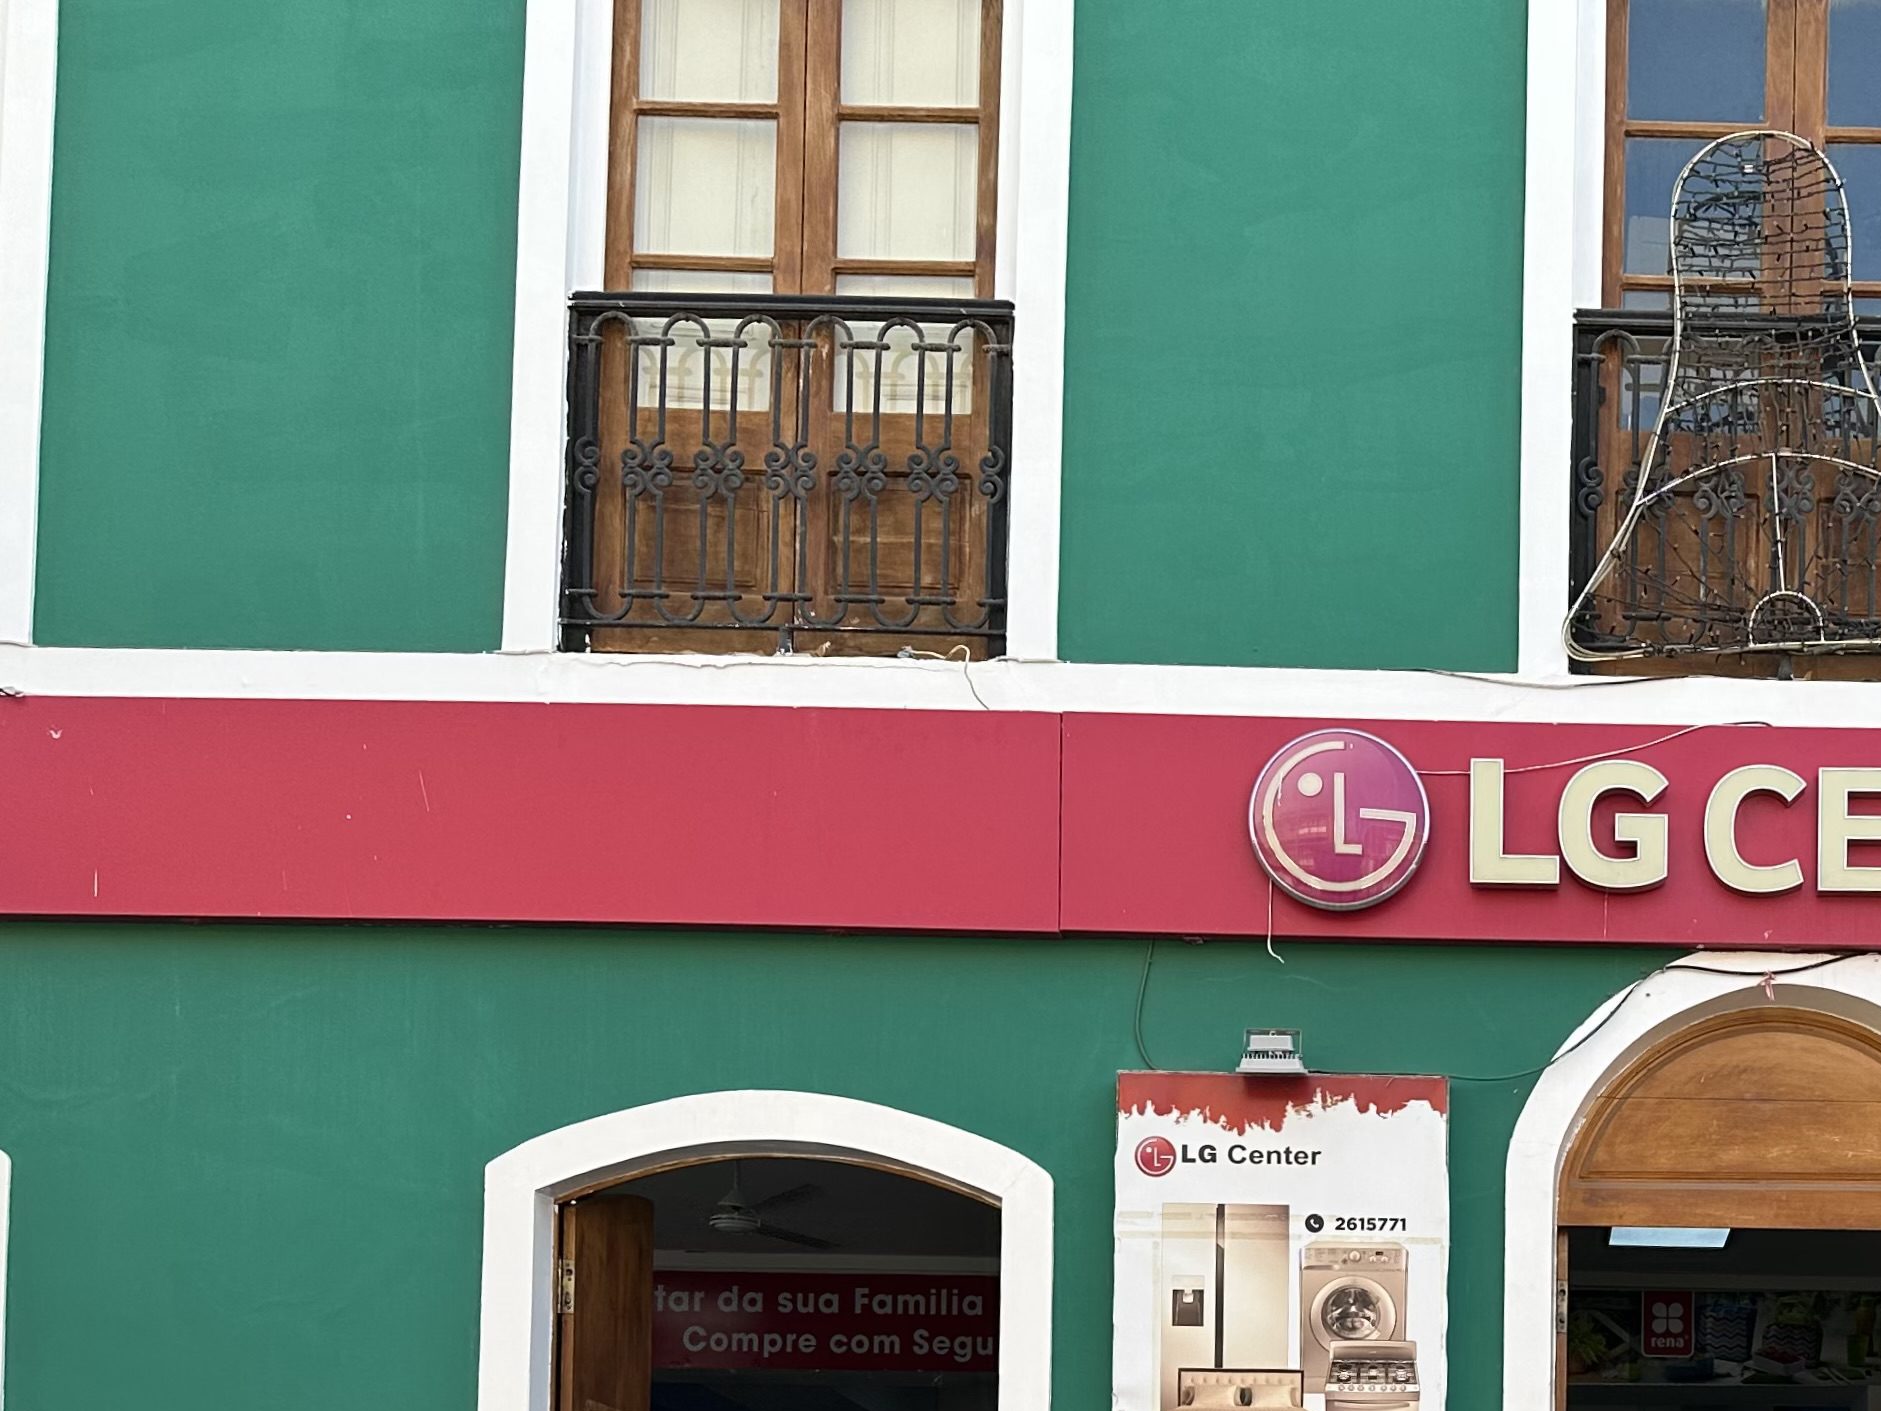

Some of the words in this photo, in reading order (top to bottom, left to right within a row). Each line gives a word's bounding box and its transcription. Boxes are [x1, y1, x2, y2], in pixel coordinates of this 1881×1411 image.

[1469, 757, 1669, 893] LG
[1181, 1144, 1217, 1163] LG
[1228, 1144, 1322, 1166] Center
[1335, 1216, 1407, 1232] 2615771
[717, 1285, 763, 1313] da
[777, 1291, 839, 1314] sua
[854, 1287, 983, 1316] Familia
[682, 1325, 817, 1358] Compre
[829, 1333, 900, 1355] com
[913, 1329, 993, 1363] Segu
